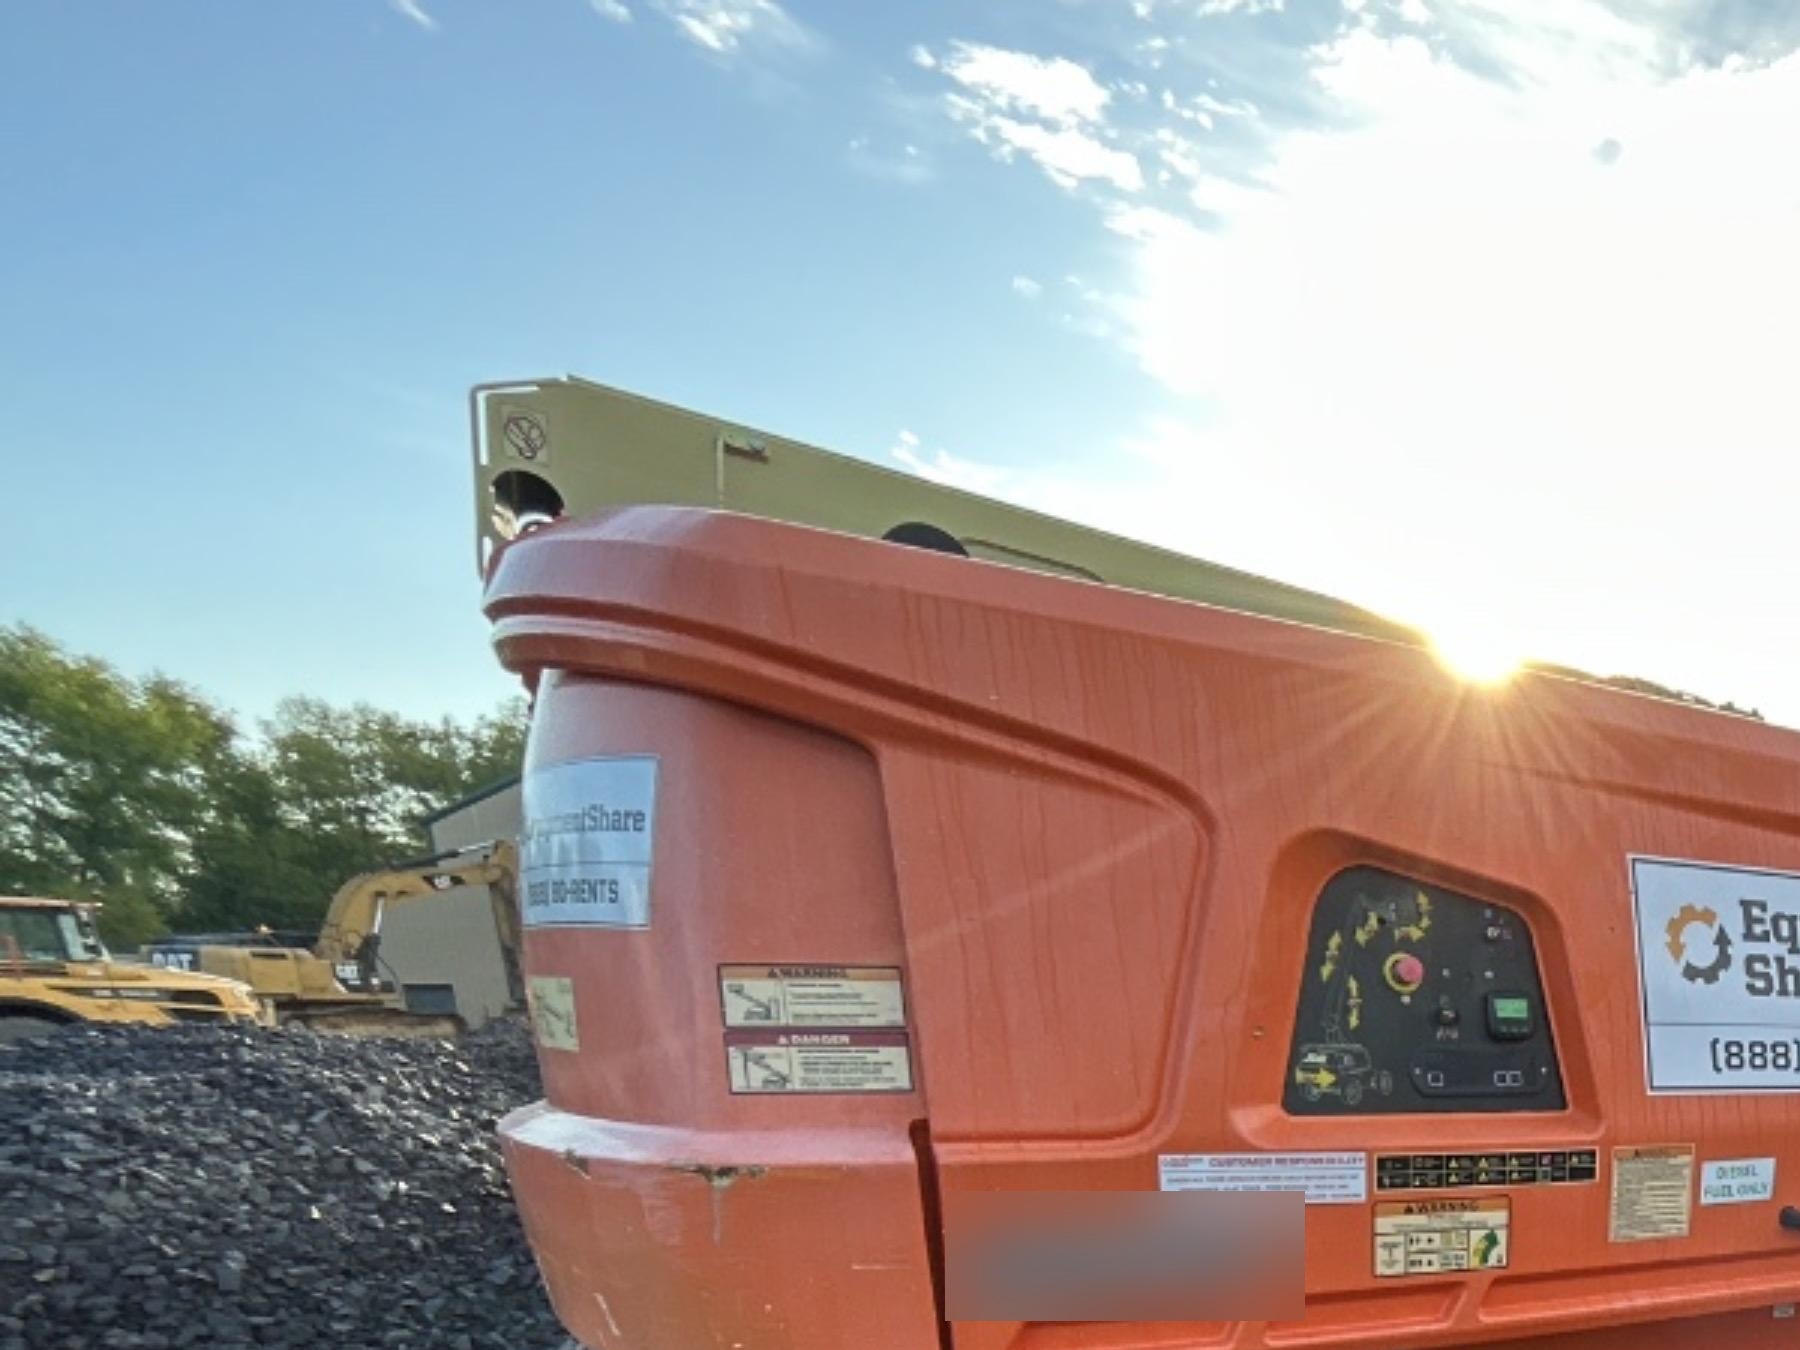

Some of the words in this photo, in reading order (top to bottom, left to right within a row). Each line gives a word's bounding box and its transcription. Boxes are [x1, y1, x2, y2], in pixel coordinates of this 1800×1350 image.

[552, 878, 619, 904] 80-RENTS
[791, 1034, 850, 1045] DANGER
[1209, 1157, 1273, 1168] CUSTOMER
[1716, 1164, 1758, 1179] DIESEL
[1704, 1184, 1734, 1198] FUEL
[1736, 1182, 1768, 1196] ONLY
[1416, 1201, 1479, 1214] WARNING
